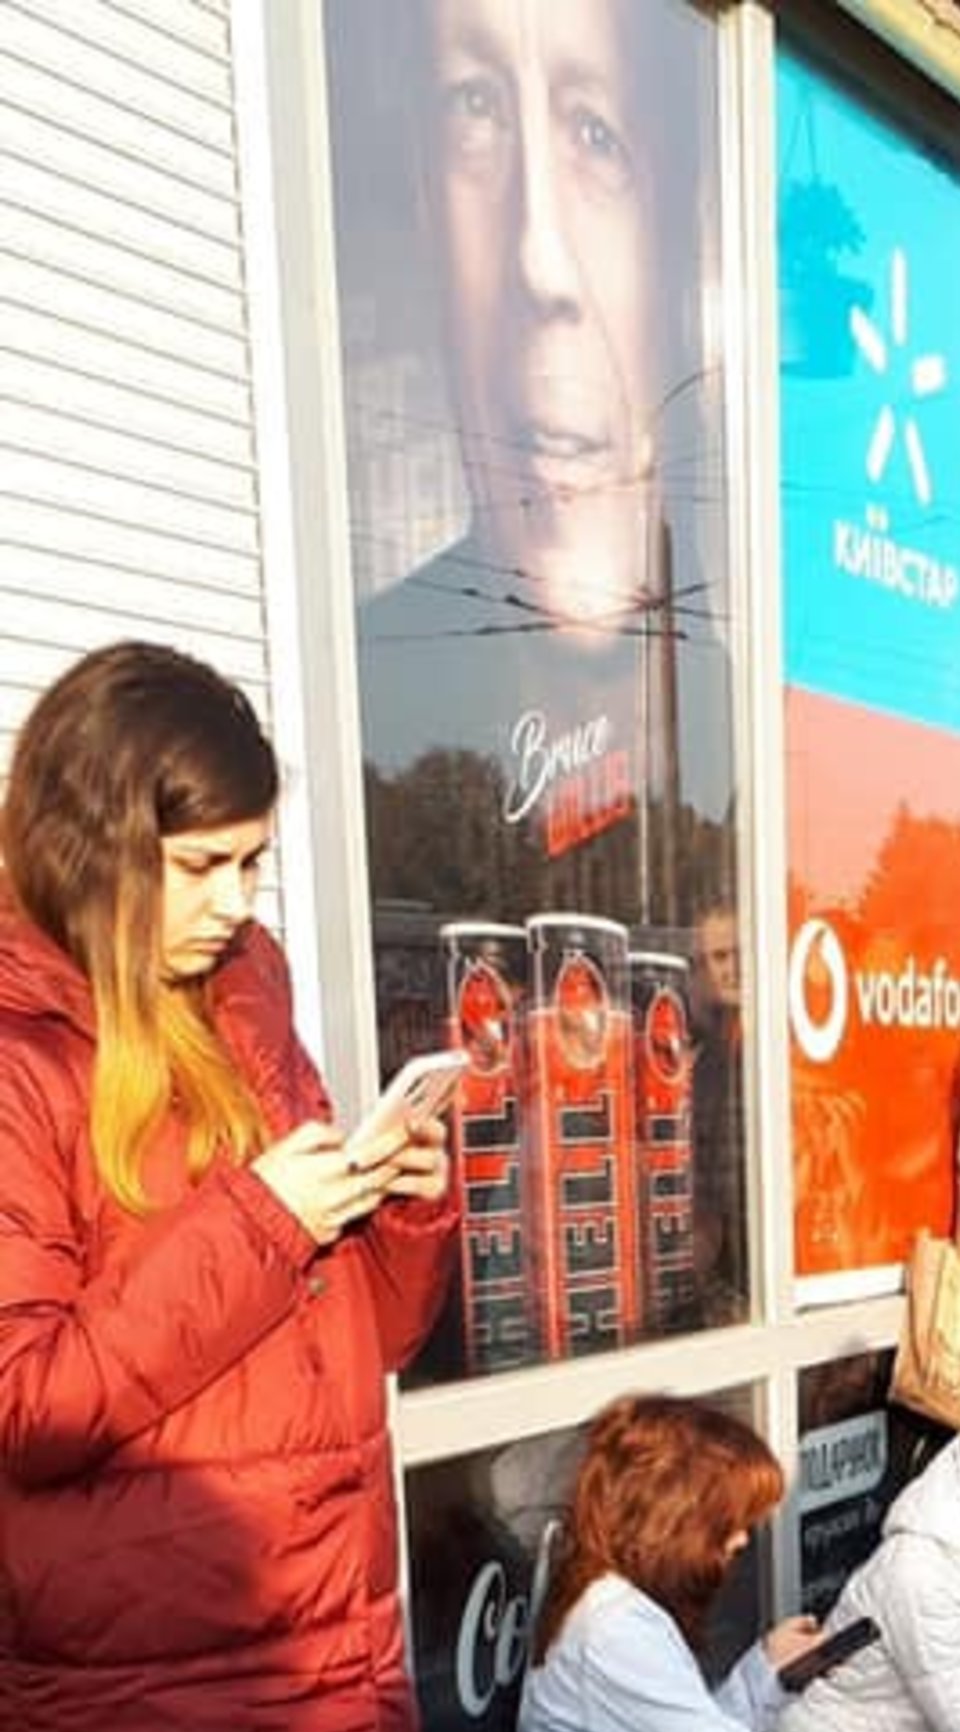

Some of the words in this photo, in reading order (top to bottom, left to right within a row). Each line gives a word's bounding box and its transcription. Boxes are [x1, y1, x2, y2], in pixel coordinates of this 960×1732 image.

[834, 503, 960, 607] КИЇВСТАР
[462, 1097, 525, 1368] HELL
[558, 1088, 623, 1352] HELL
